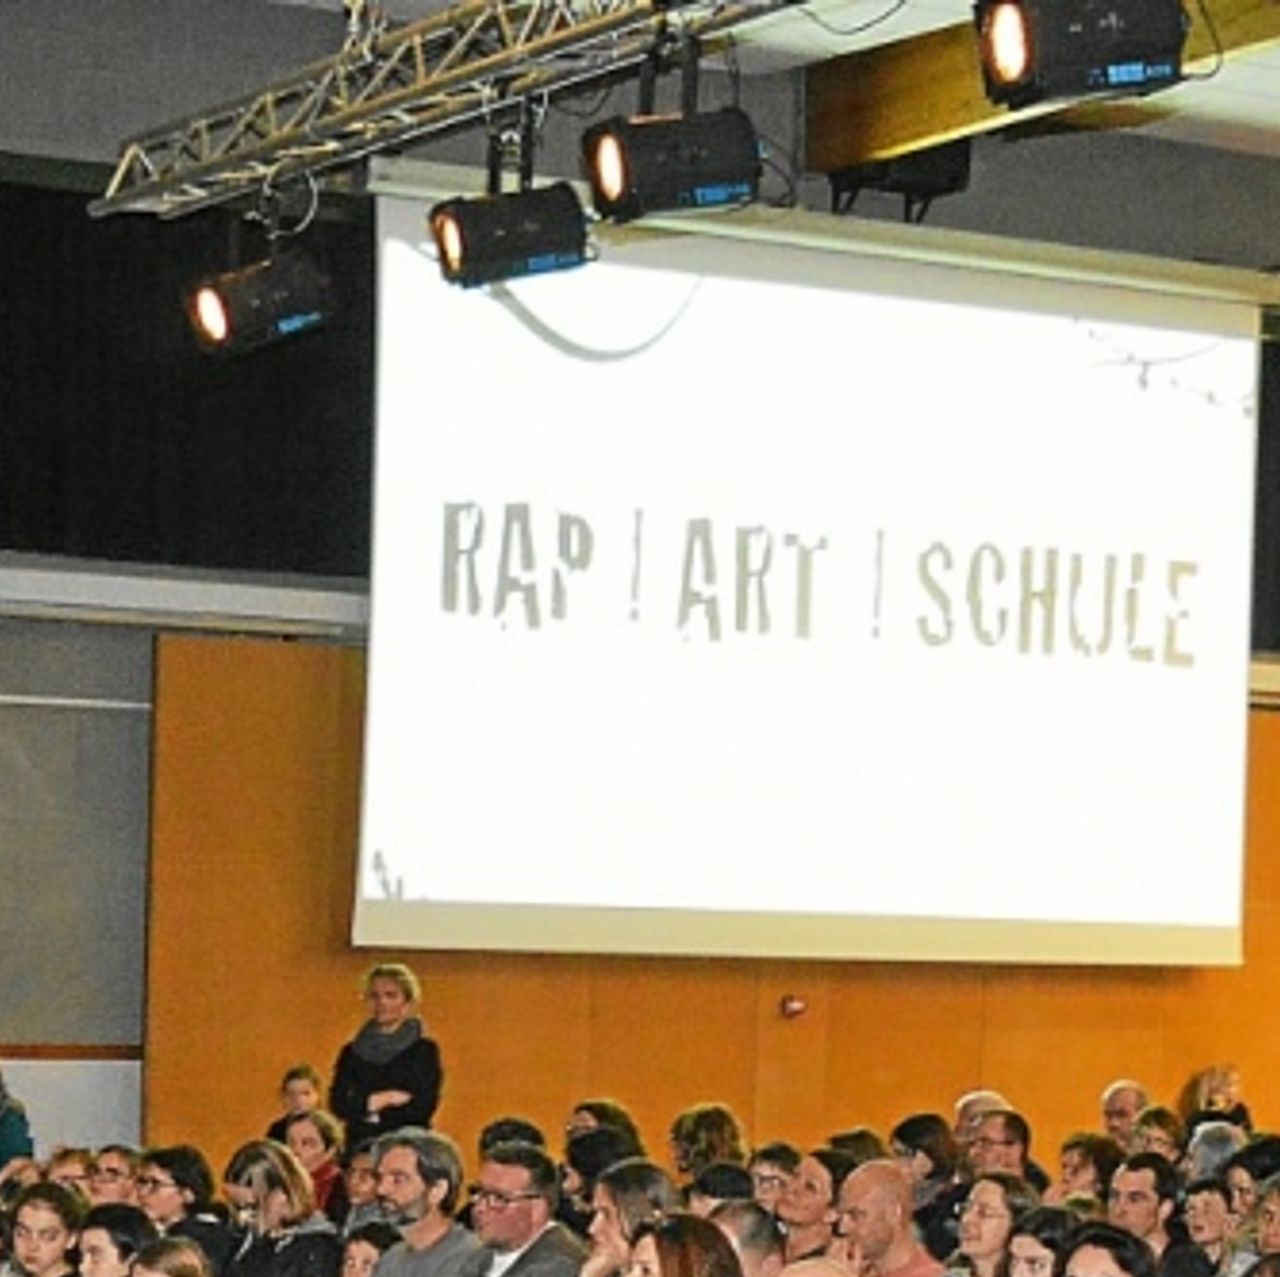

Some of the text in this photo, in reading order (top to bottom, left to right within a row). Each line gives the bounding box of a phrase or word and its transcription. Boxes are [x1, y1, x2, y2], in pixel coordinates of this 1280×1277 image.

[441, 501, 594, 630] RAP
[676, 518, 829, 642] ART
[916, 540, 1199, 669] SCHULE
